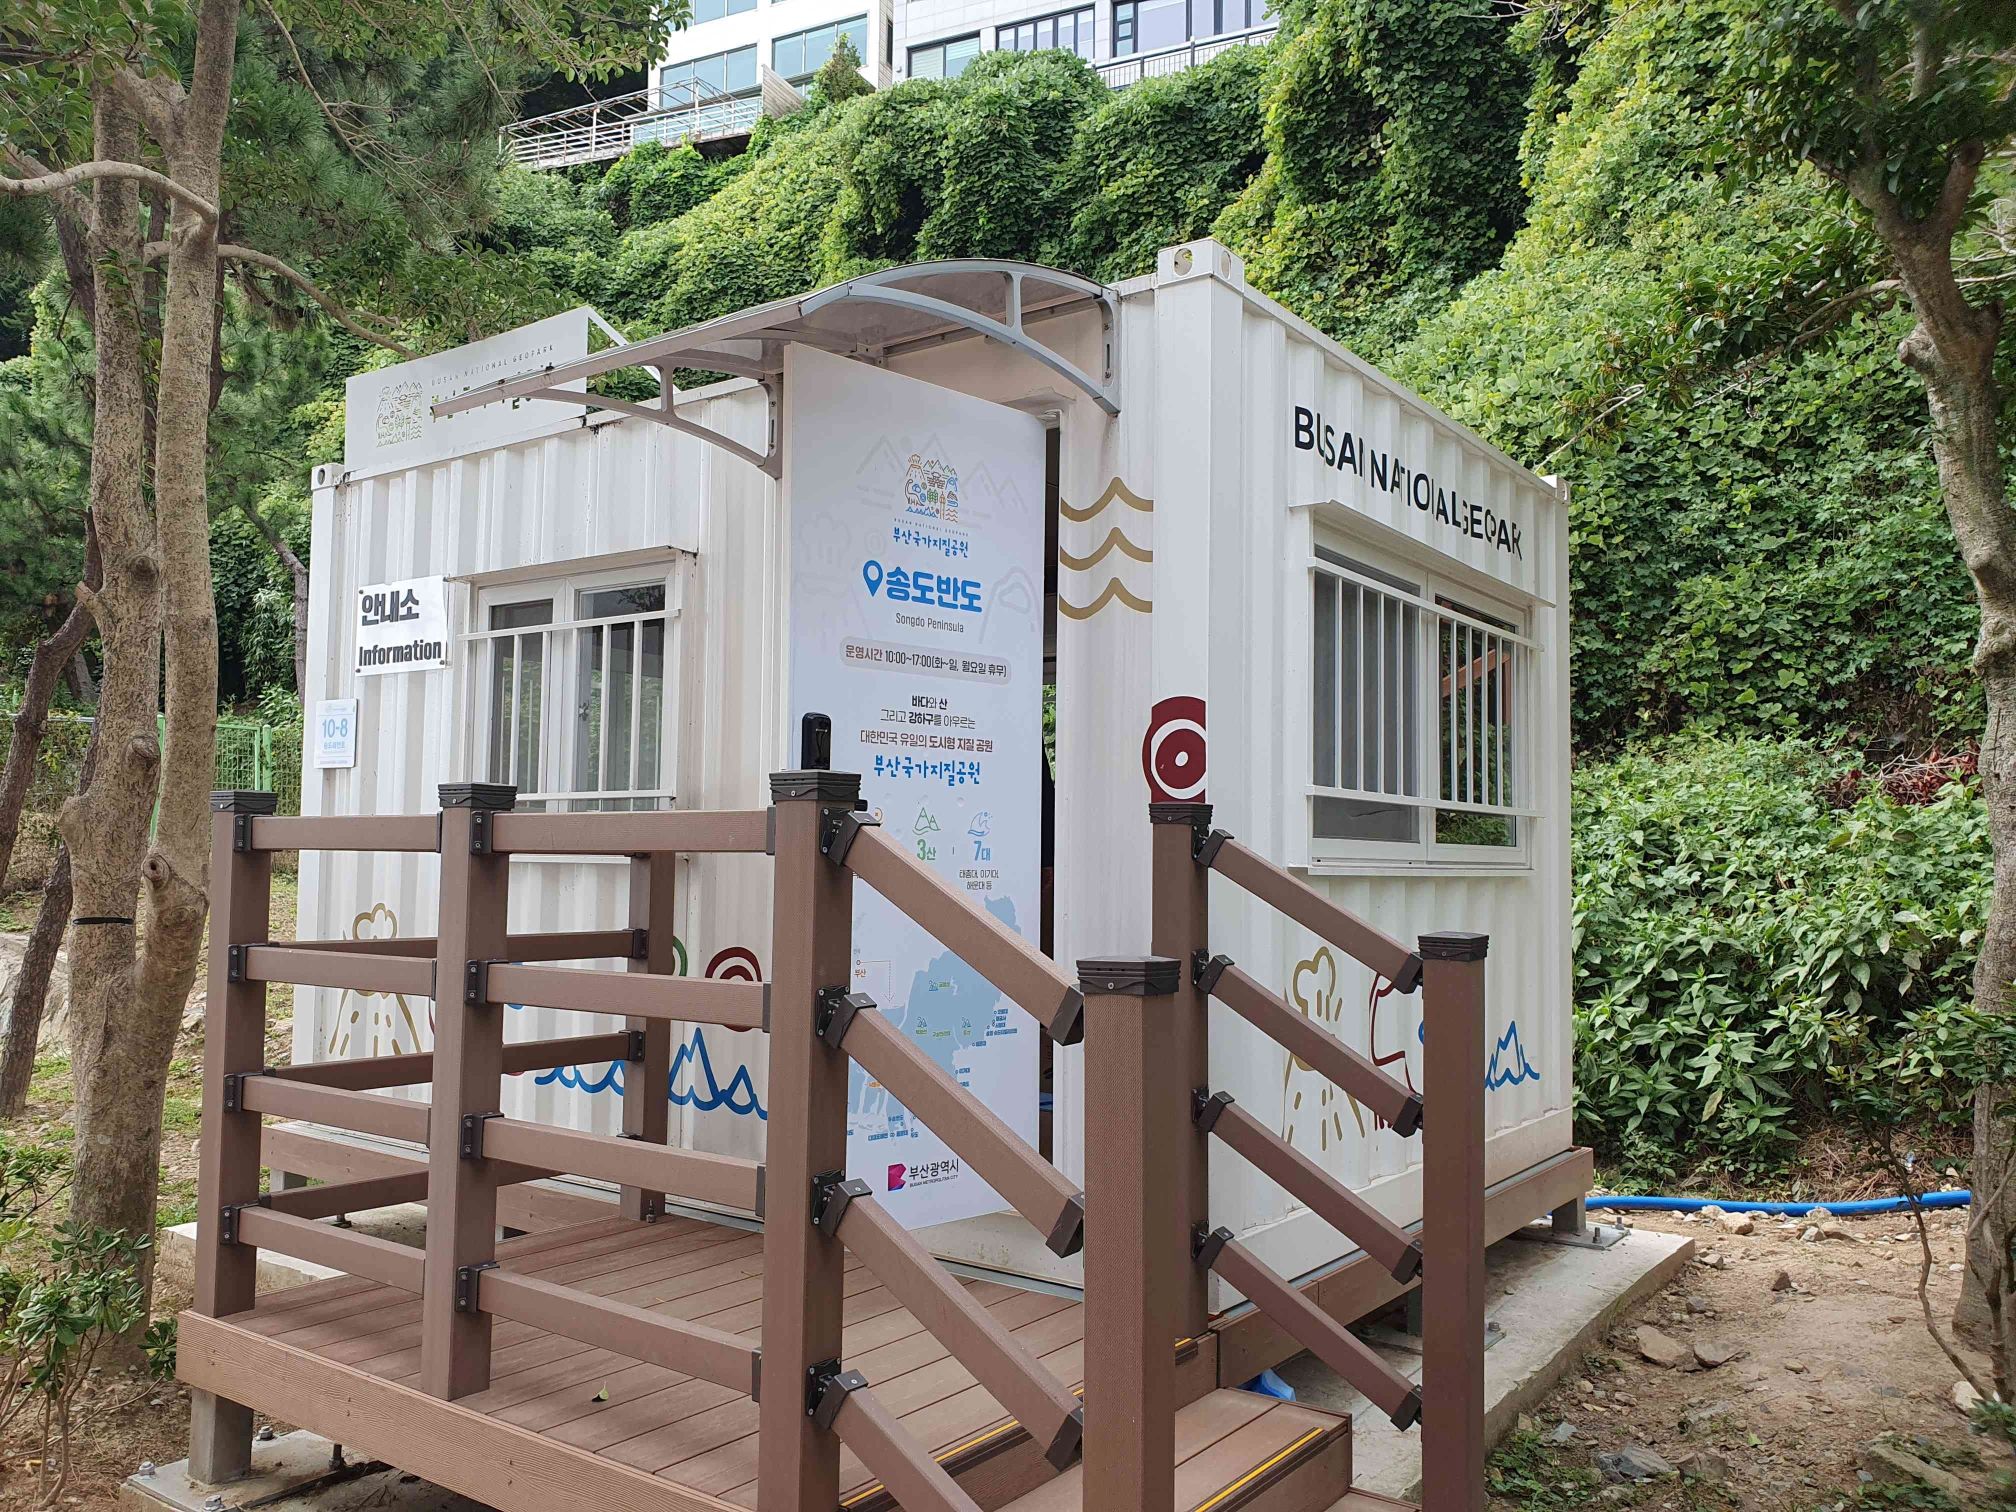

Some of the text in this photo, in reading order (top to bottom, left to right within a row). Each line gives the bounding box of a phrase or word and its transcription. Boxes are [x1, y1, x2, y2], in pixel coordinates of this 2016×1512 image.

[1371, 449, 1461, 529] NATIOAL
[893, 526, 969, 558] 부산국가지질공원
[886, 566, 983, 613] 송도반도
[362, 588, 420, 626] 안내소
[895, 612, 964, 633] Songdo Peninsula
[359, 639, 442, 667] Information
[845, 644, 883, 662] 운영시간
[962, 660, 987, 675] 월요일
[988, 663, 1007, 677] 휴무)
[911, 694, 948, 710] 바다와 산
[322, 718, 348, 739] 10-8
[880, 708, 976, 730] 그리고 강하구를 아우르는
[860, 730, 993, 753] 대한민국 유일의 도시형 지질 공원
[873, 754, 980, 786] 부산국가지질공원
[917, 839, 937, 861] 3산
[973, 840, 991, 861] 7대
[908, 1158, 959, 1180] 부산광역시
